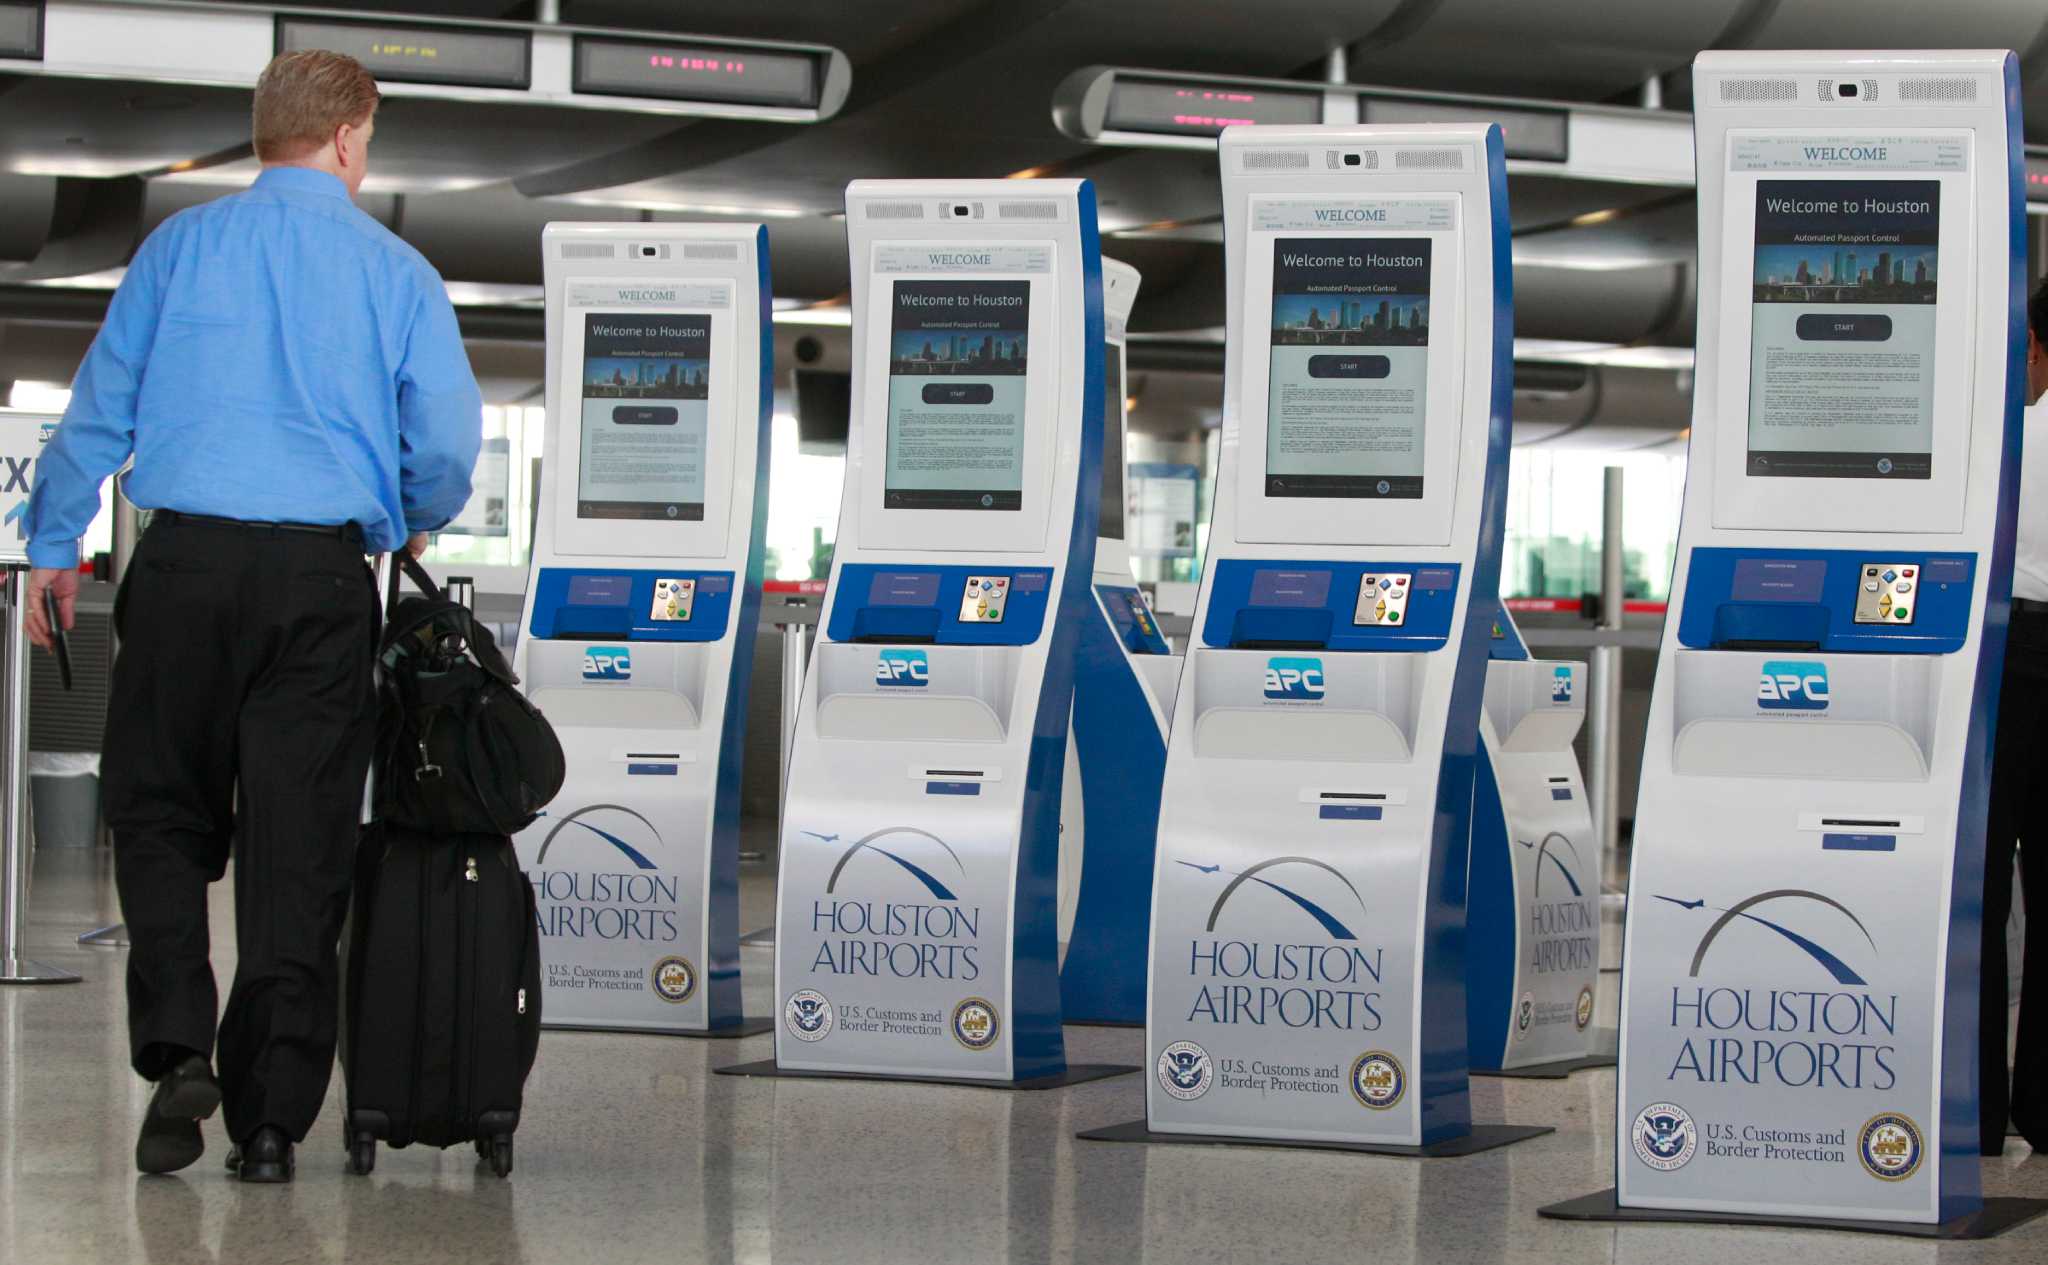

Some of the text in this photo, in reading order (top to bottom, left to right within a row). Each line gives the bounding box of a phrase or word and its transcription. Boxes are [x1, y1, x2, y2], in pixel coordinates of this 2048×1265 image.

[1804, 147, 1887, 161] WELCOME
[1766, 198, 1929, 214] Welcome to Houston
[1315, 209, 1386, 221] WELCOME
[1794, 233, 1900, 244] Automated Passport Control
[929, 254, 991, 265] WELCOME
[1283, 254, 1423, 267] Welcome to Houston
[618, 290, 676, 301] WELCOME
[1307, 284, 1398, 293] Automated Passport Control
[900, 294, 1023, 306] Welcome to Houston
[593, 325, 705, 337] Welcome to Houston
[1834, 323, 1854, 331] START
[524, 871, 678, 904] HOUSTON
[812, 901, 979, 938] HOUSTON
[1531, 901, 1592, 935] HOUSTON
[810, 940, 979, 981] AIRPORTS
[1190, 940, 1383, 984] HOUSTON
[1531, 937, 1592, 974] AIRPORTS
[549, 965, 643, 979] U.S. Customs and
[549, 976, 643, 991] Border Protection
[840, 1006, 942, 1023] U.S. Customs and
[1187, 984, 1382, 1031] AIRPORTS
[1671, 986, 1897, 1036] HOUSTON
[840, 1019, 942, 1036] Border Protection
[1221, 1060, 1339, 1078] U.S. Customs and
[1667, 1037, 1896, 1090] AIRPORTS
[1221, 1074, 1339, 1094] Border Protection
[1706, 1124, 1845, 1146] U.S. Customs and
[1706, 1140, 1845, 1163] Border Protection
